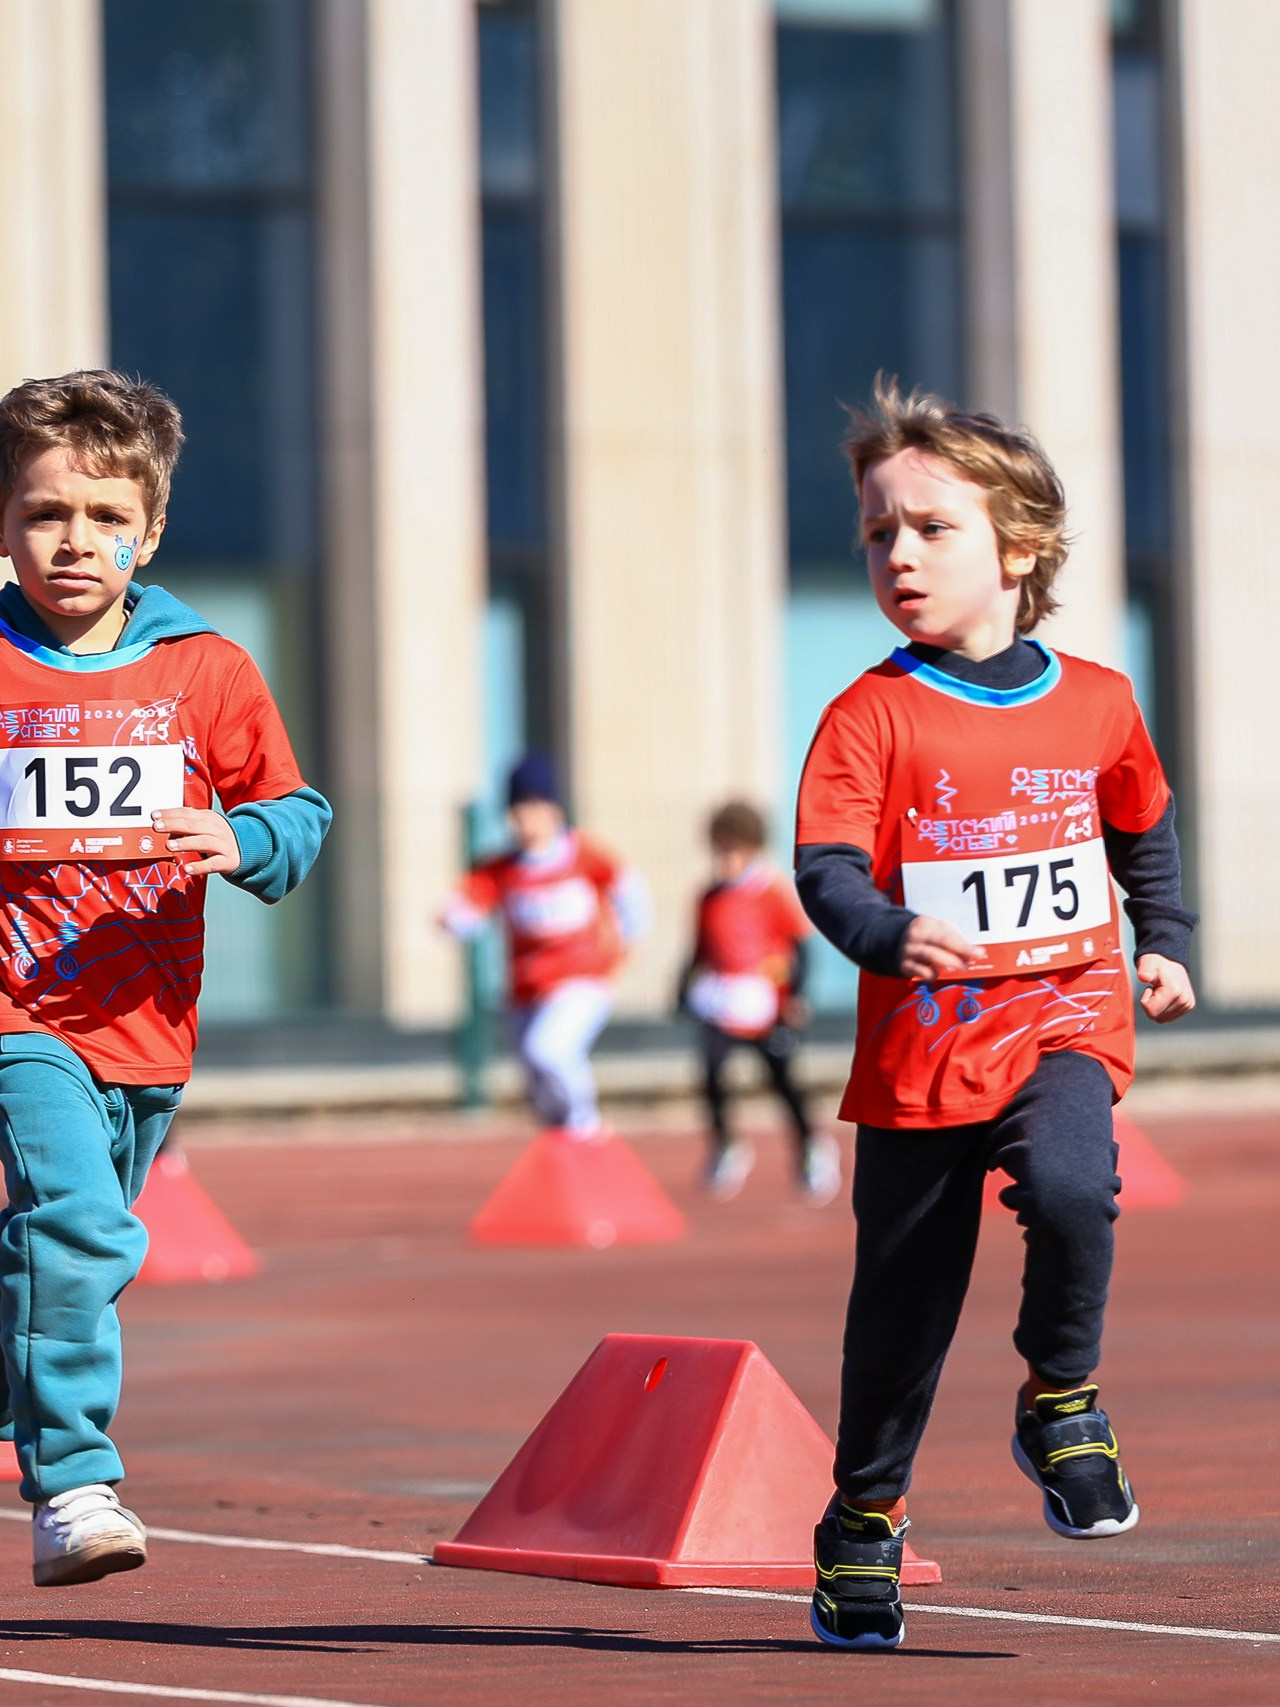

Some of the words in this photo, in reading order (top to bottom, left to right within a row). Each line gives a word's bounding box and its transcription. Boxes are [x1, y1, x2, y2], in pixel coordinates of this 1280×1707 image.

[84, 709, 124, 720] 2026
[24, 756, 142, 818] 152
[962, 857, 1080, 932] 175
